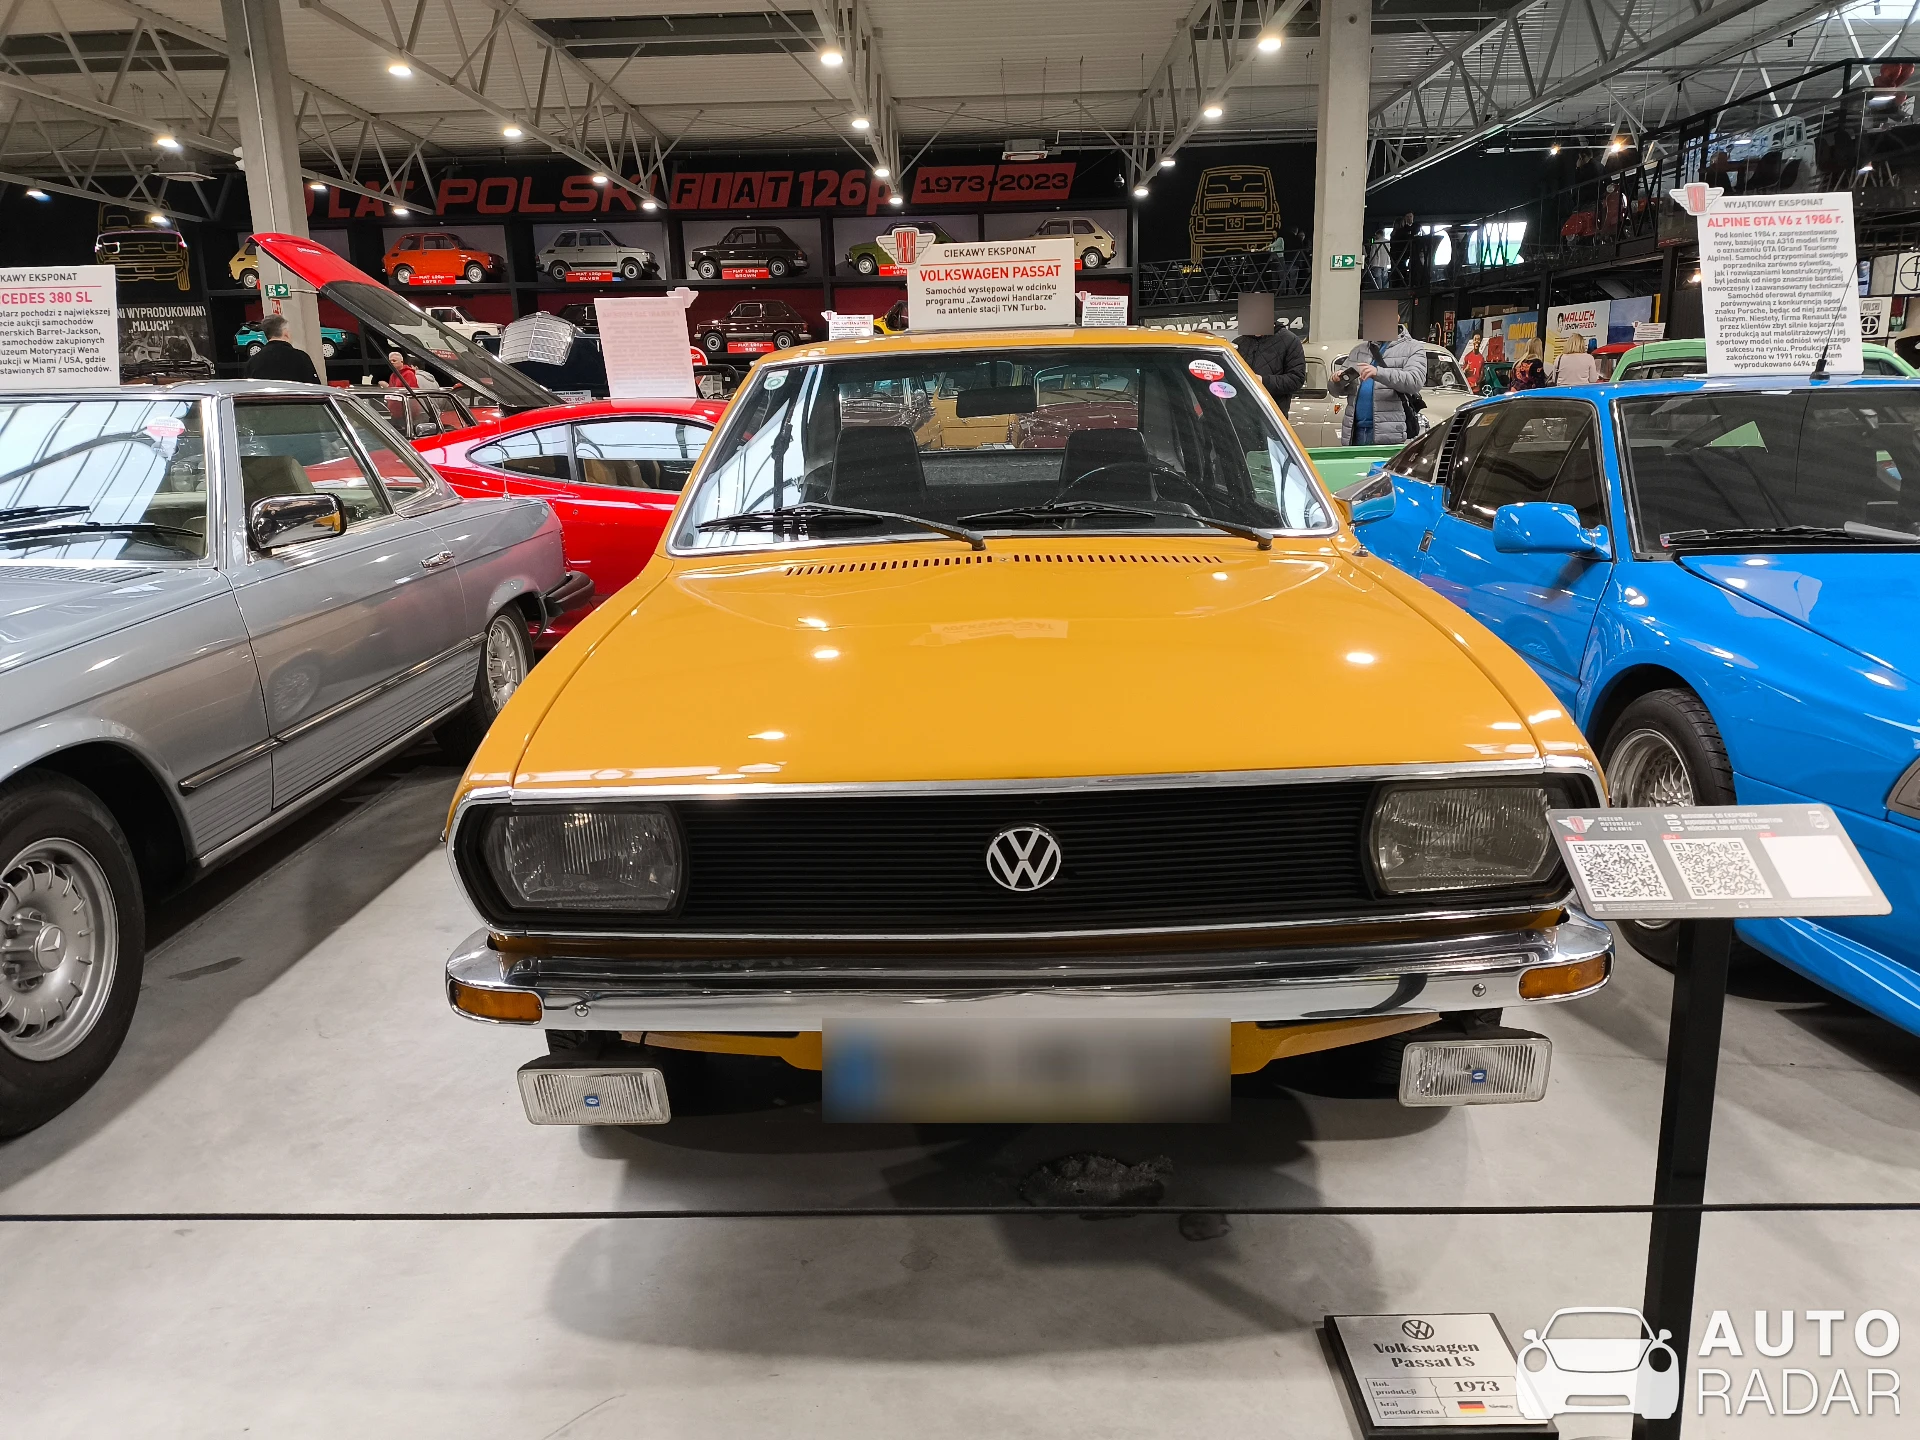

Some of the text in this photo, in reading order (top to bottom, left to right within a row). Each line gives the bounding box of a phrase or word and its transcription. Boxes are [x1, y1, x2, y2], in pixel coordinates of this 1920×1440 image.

[671, 171, 794, 209] FIAT
[799, 169, 895, 215] 126p
[920, 172, 1070, 194] 1973-2023
[1724, 198, 1823, 210] WYJĄTKOWY EKSPONAT
[1707, 217, 1750, 228] ALPINE
[1754, 216, 1775, 226] GTA
[1778, 216, 1793, 226] V6
[1805, 214, 1832, 224] 1986
[1835, 215, 1844, 224] r.
[1820, 236, 1840, 244] firmy
[944, 246, 1037, 258] CIEKAWY EKSPONAT
[1722, 246, 1761, 254] oznaczeniu
[1723, 262, 1766, 270] poprzednika
[29, 273, 77, 282] EKSPONAT
[920, 265, 1062, 282] VOLKSWAGEN PASSAT
[1726, 277, 1750, 285] jednak
[1762, 276, 1781, 284] niego
[1814, 274, 1844, 282] bardziej
[926, 285, 966, 294] Samochód
[968, 284, 1015, 295] występował
[1025, 283, 1057, 292] odcinku
[0, 291, 92, 304] CEDES 380 SL
[926, 292, 1057, 306] programu „Zawodowi Handlarze”
[20, 309, 56, 318] pochodzi
[64, 308, 110, 318] największej
[948, 306, 978, 314] antenie
[980, 304, 1001, 315] stacji
[1002, 304, 1018, 312] TVN
[1020, 304, 1047, 312] Turbo.
[1802, 306, 1816, 314] niej
[1564, 310, 1596, 322] MALUCH
[16, 319, 40, 328] aukcji
[42, 318, 94, 326] samochodów
[129, 320, 174, 334] „MALUCH”
[1740, 322, 1770, 330] klientów
[36, 327, 100, 336] Barret-Jackson,
[2, 337, 104, 346] samochodów zakupionych
[0, 346, 100, 356] uzeum Motoryzacji Wena
[32, 356, 56, 364] Miami
[64, 356, 82, 364] USA,
[85, 356, 106, 365] gdzie
[1734, 360, 1792, 369] wyprodukowano
[46, 366, 56, 374] 87
[58, 364, 112, 374] samochodów.
[1373, 1342, 1480, 1354] Volkswagen
[1392, 1356, 1476, 1368] Passat LS
[1454, 1380, 1500, 1392] 1973
